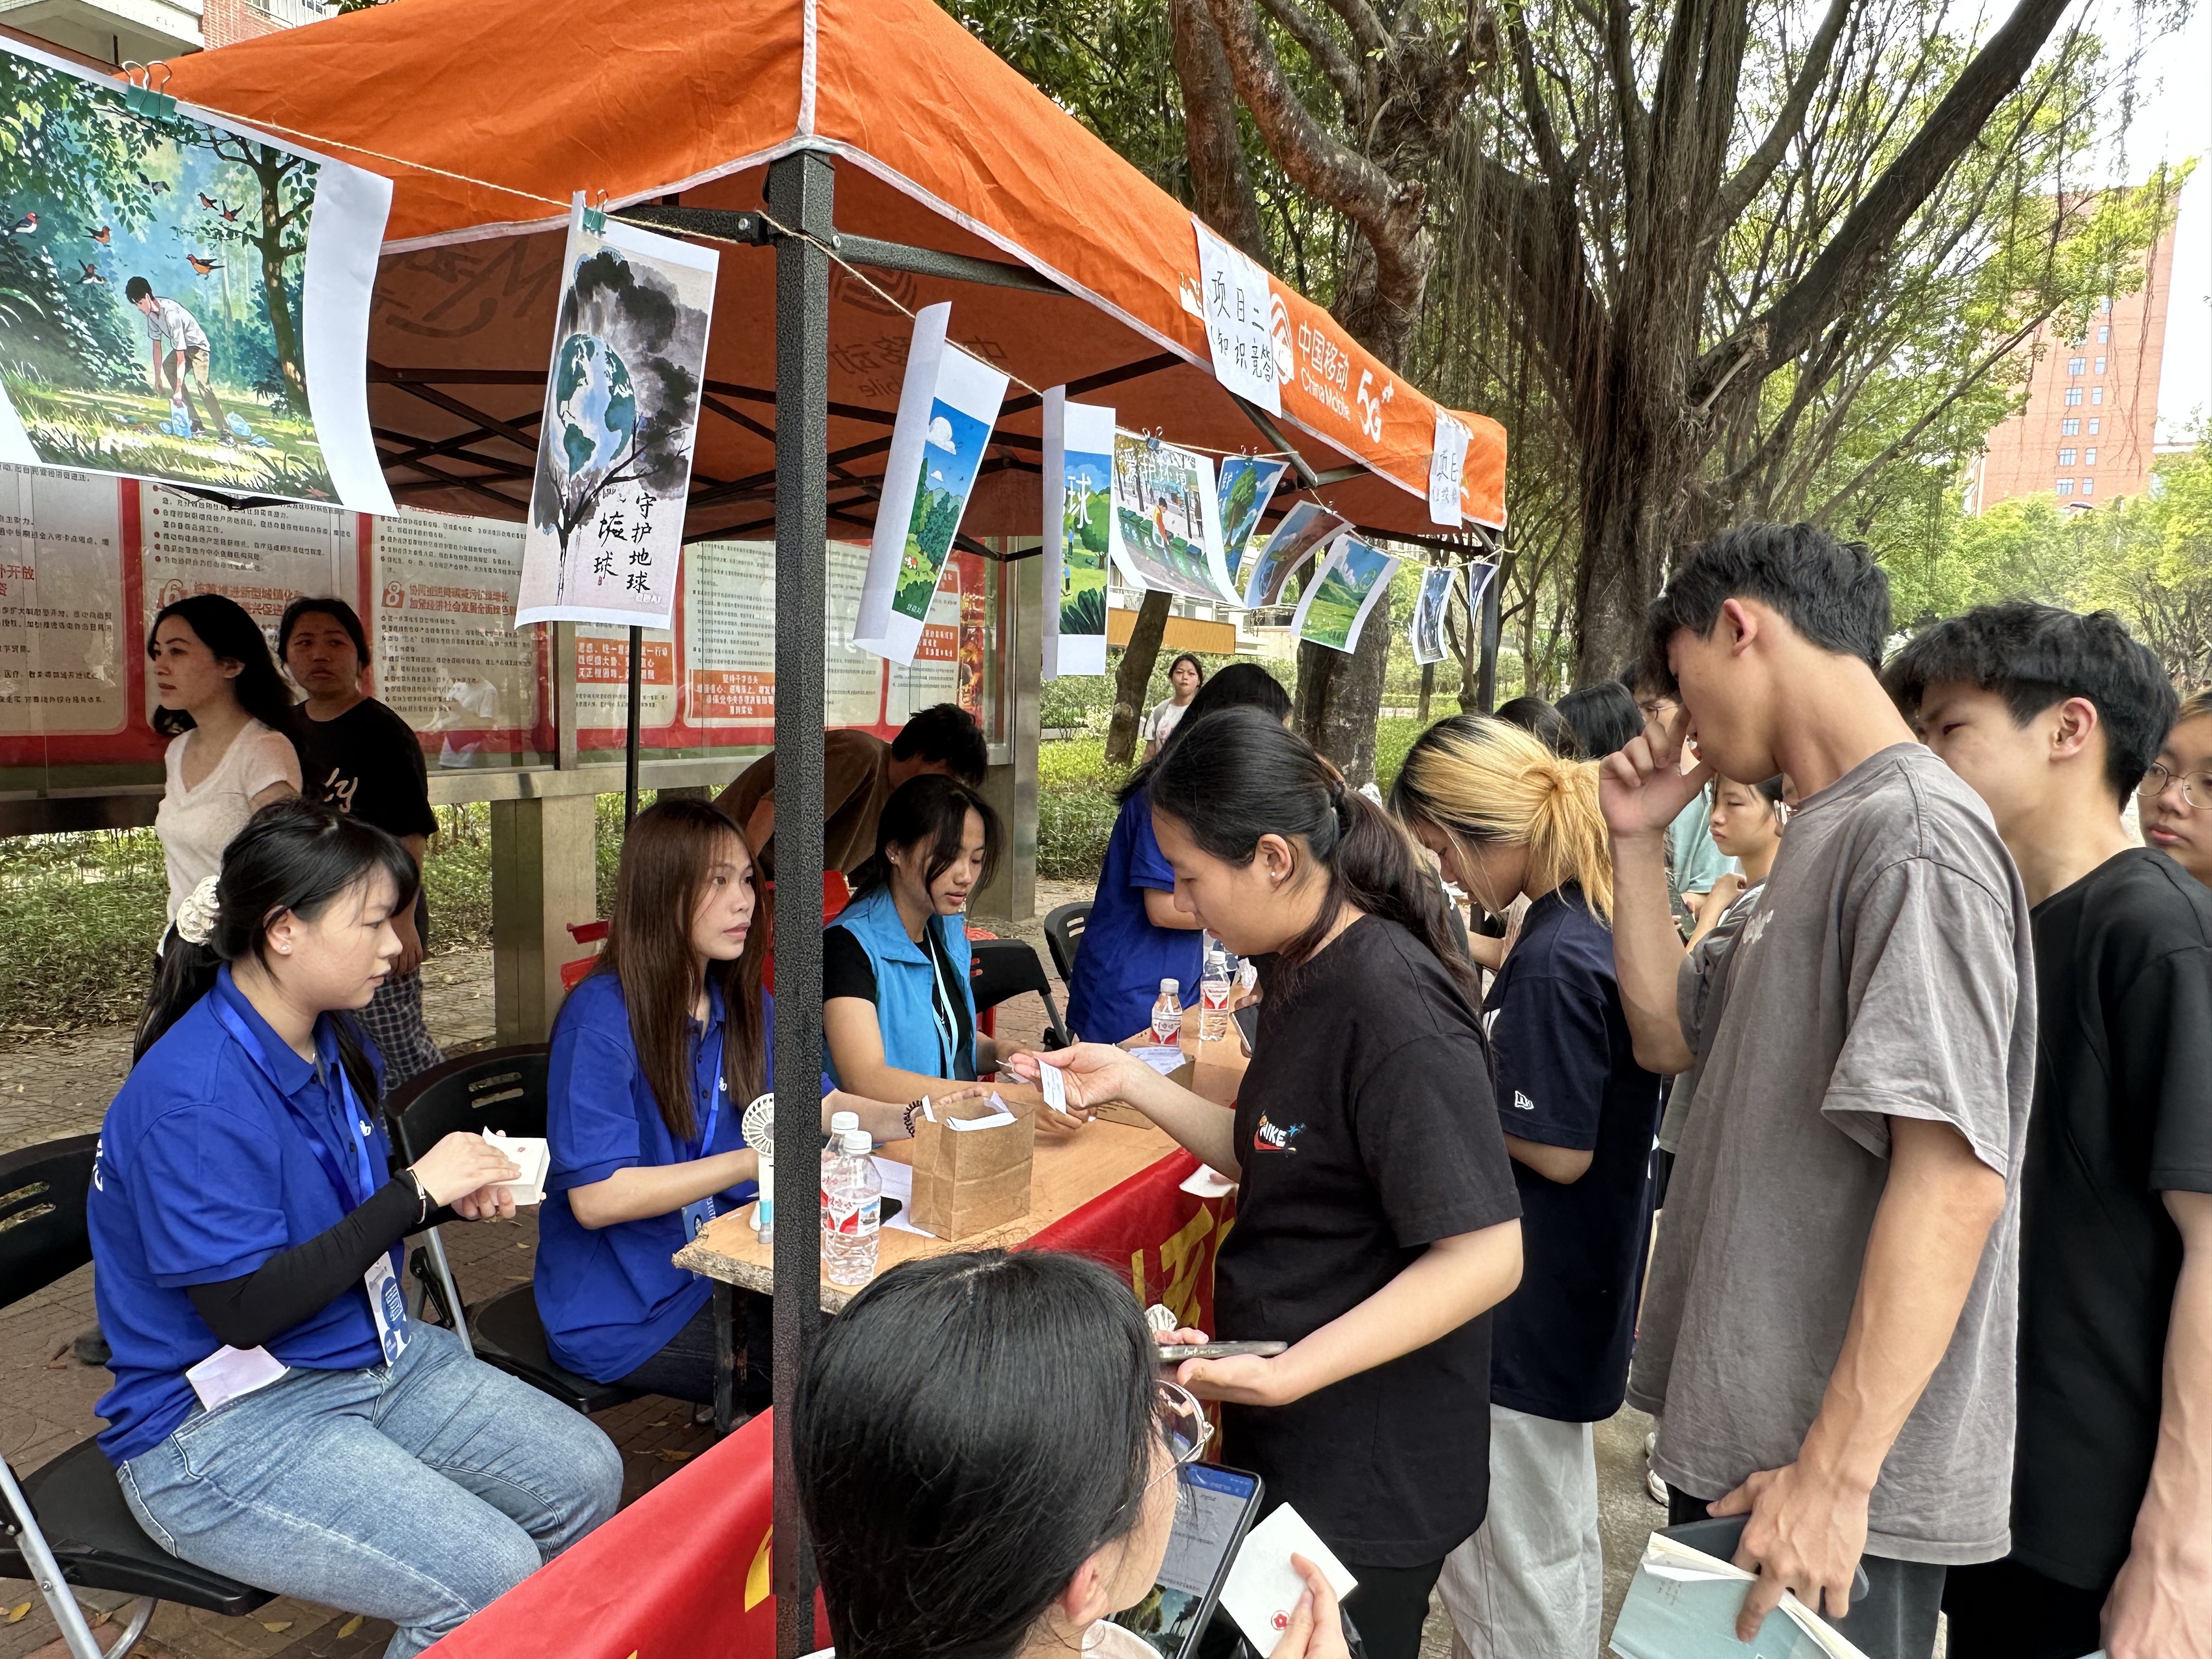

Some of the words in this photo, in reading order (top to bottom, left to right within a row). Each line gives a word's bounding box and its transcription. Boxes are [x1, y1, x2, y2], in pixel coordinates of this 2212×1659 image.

[1211, 271, 1265, 331] 项目二
[1298, 320, 1349, 392] 中国移动
[1063, 473, 1092, 529] 球
[627, 492, 657, 593] 守护地球
[386, 581, 402, 606] 8
[1260, 1121, 1287, 1147] NIKE
